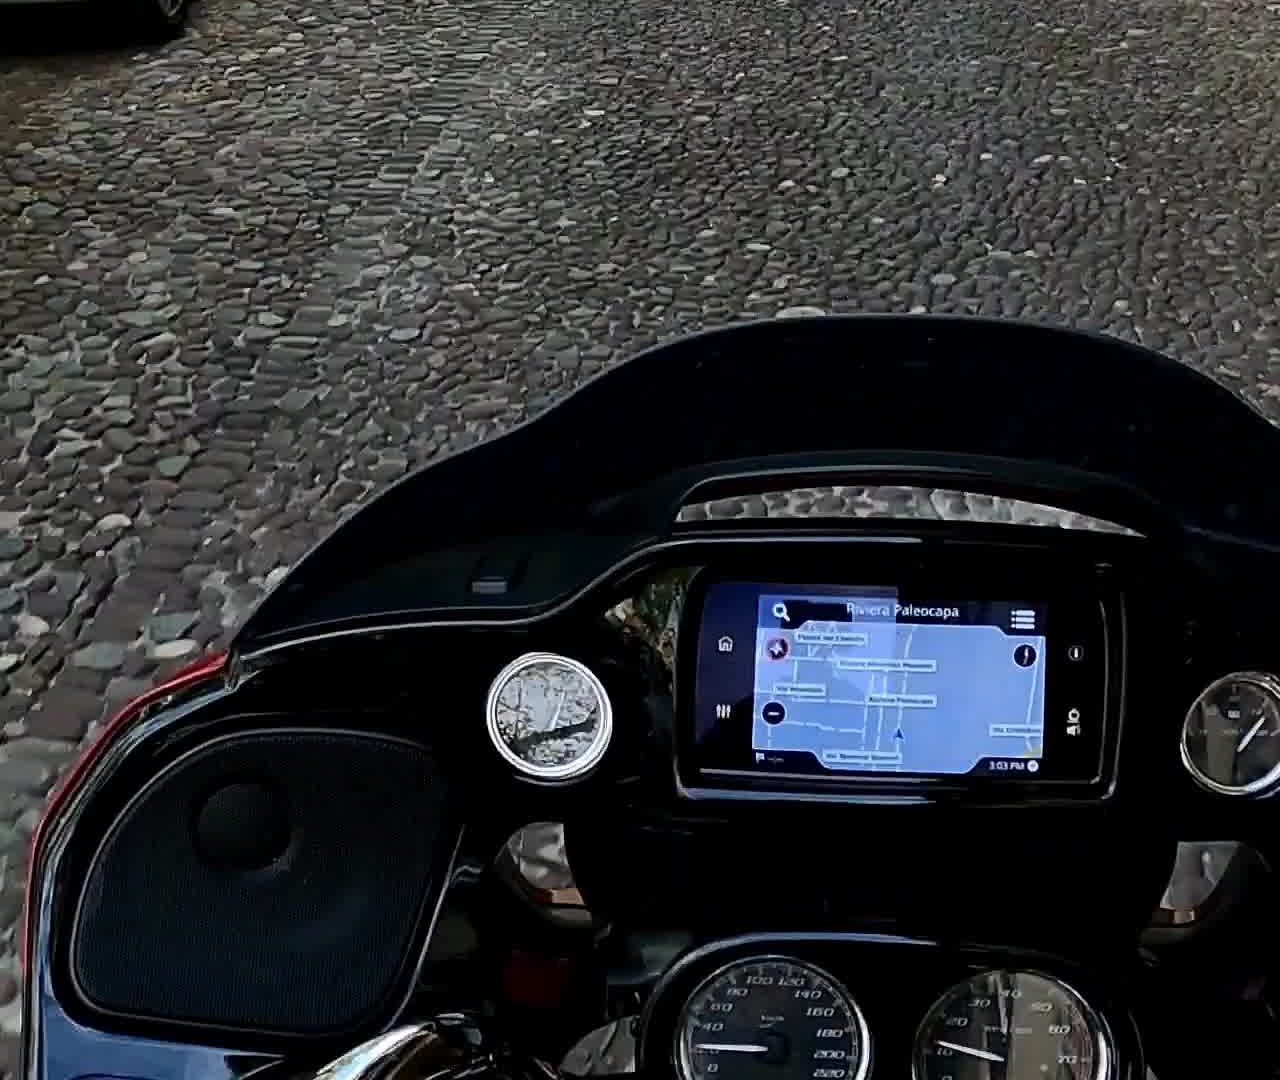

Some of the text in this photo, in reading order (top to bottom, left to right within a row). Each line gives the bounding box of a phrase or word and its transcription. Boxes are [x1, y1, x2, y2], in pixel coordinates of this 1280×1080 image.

[895, 604, 960, 620] Paleocapa
[746, 976, 773, 985] 100
[794, 990, 822, 999] 140
[816, 1029, 844, 1038] 180
[814, 1050, 845, 1059] 200
